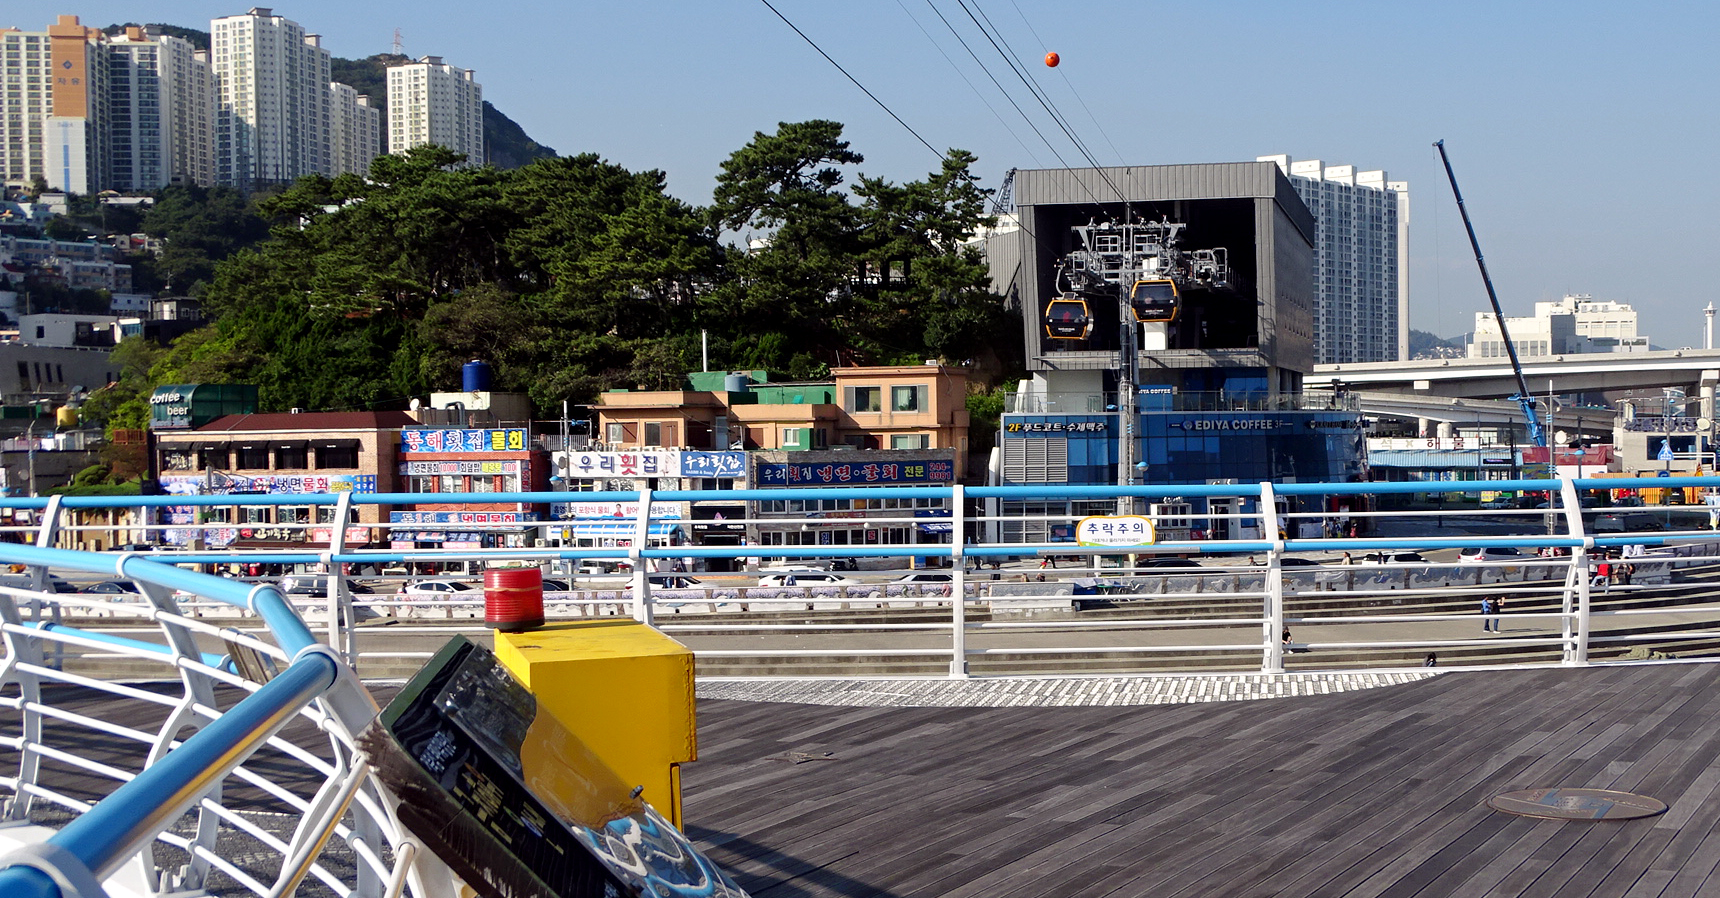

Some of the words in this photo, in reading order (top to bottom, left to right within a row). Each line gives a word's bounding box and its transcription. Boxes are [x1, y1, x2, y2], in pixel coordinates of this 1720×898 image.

[150, 392, 180, 404] coffee
[167, 406, 189, 416] beer
[1008, 423, 1022, 432] 2F
[1195, 420, 1230, 430] EDIYA
[1232, 419, 1273, 430] COFFEE
[406, 430, 485, 452] 동해횟집
[491, 430, 523, 451] 물회
[578, 454, 659, 475] 우리횟집
[764, 465, 813, 482] 우리횟집
[904, 465, 925, 478] 전문
[277, 477, 329, 492] 냉면물회
[1087, 523, 1145, 536] 추락주의
